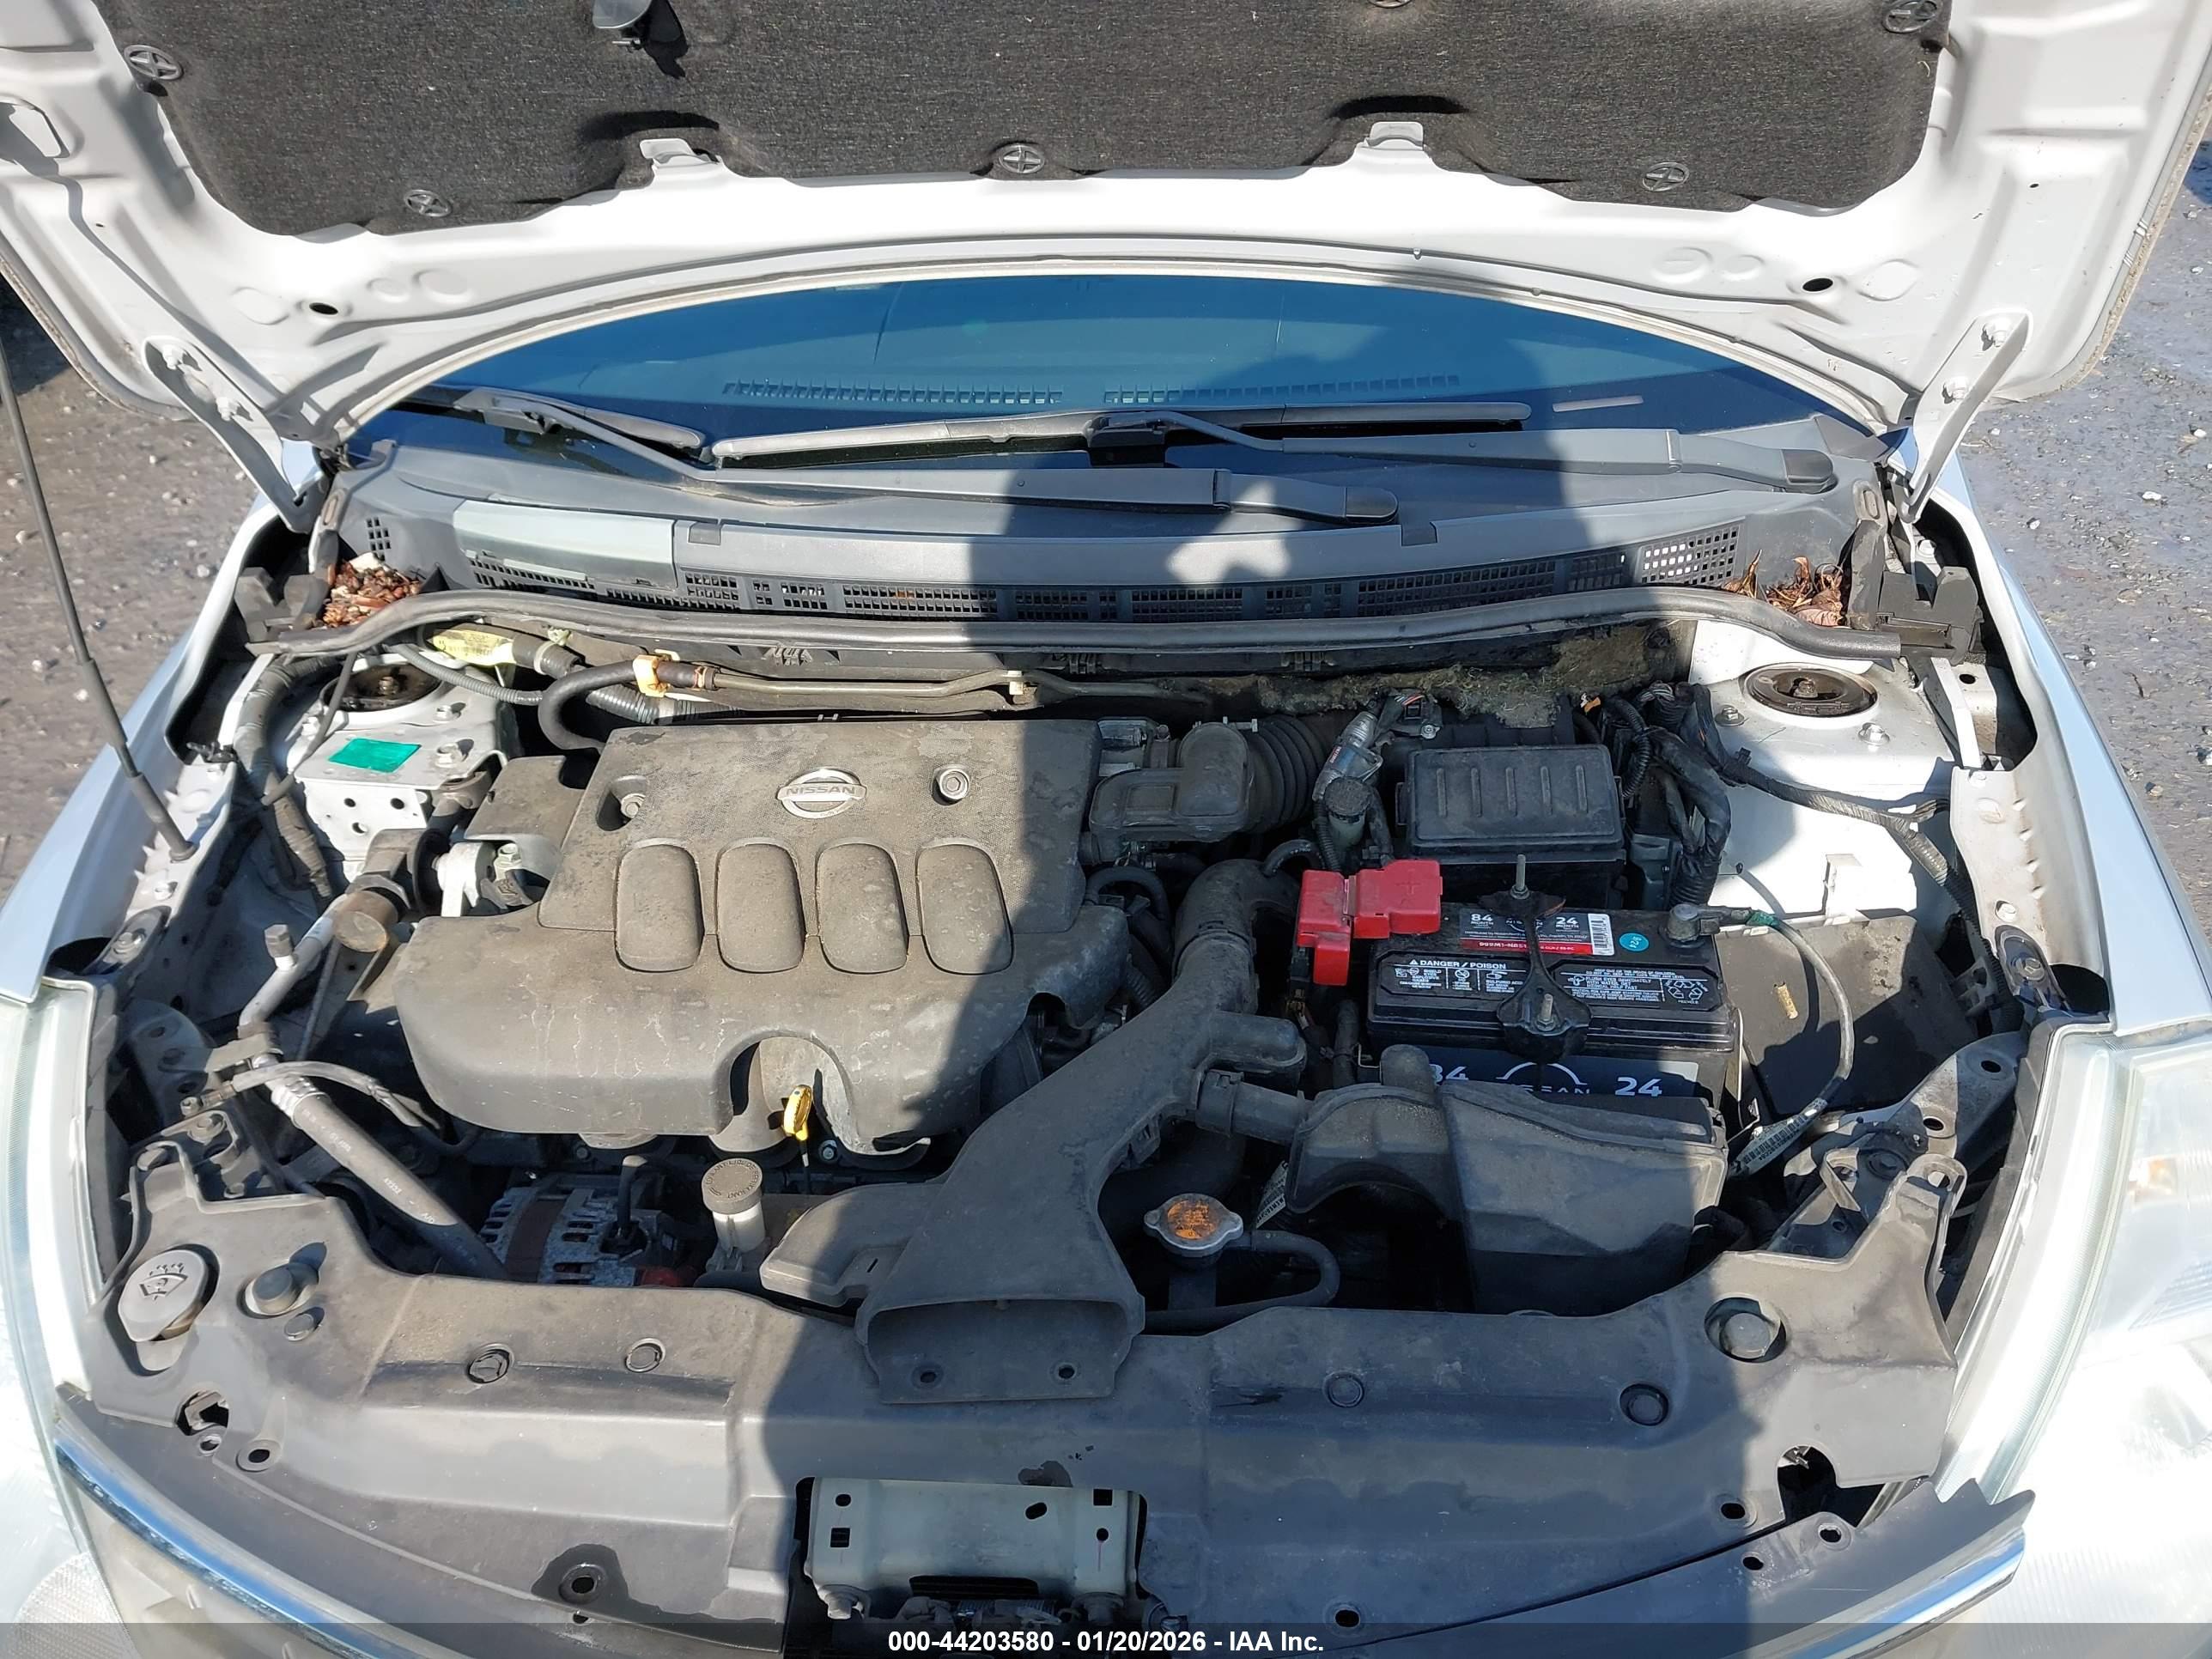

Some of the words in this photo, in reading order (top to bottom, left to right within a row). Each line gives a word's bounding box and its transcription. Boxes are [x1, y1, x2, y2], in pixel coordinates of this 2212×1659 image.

[785, 785, 856, 796] NISSAN
[1470, 913, 1493, 922] 84
[1555, 916, 1578, 925] 24
[1419, 959, 1460, 968] DANGER
[1614, 1077, 1662, 1097] 24
